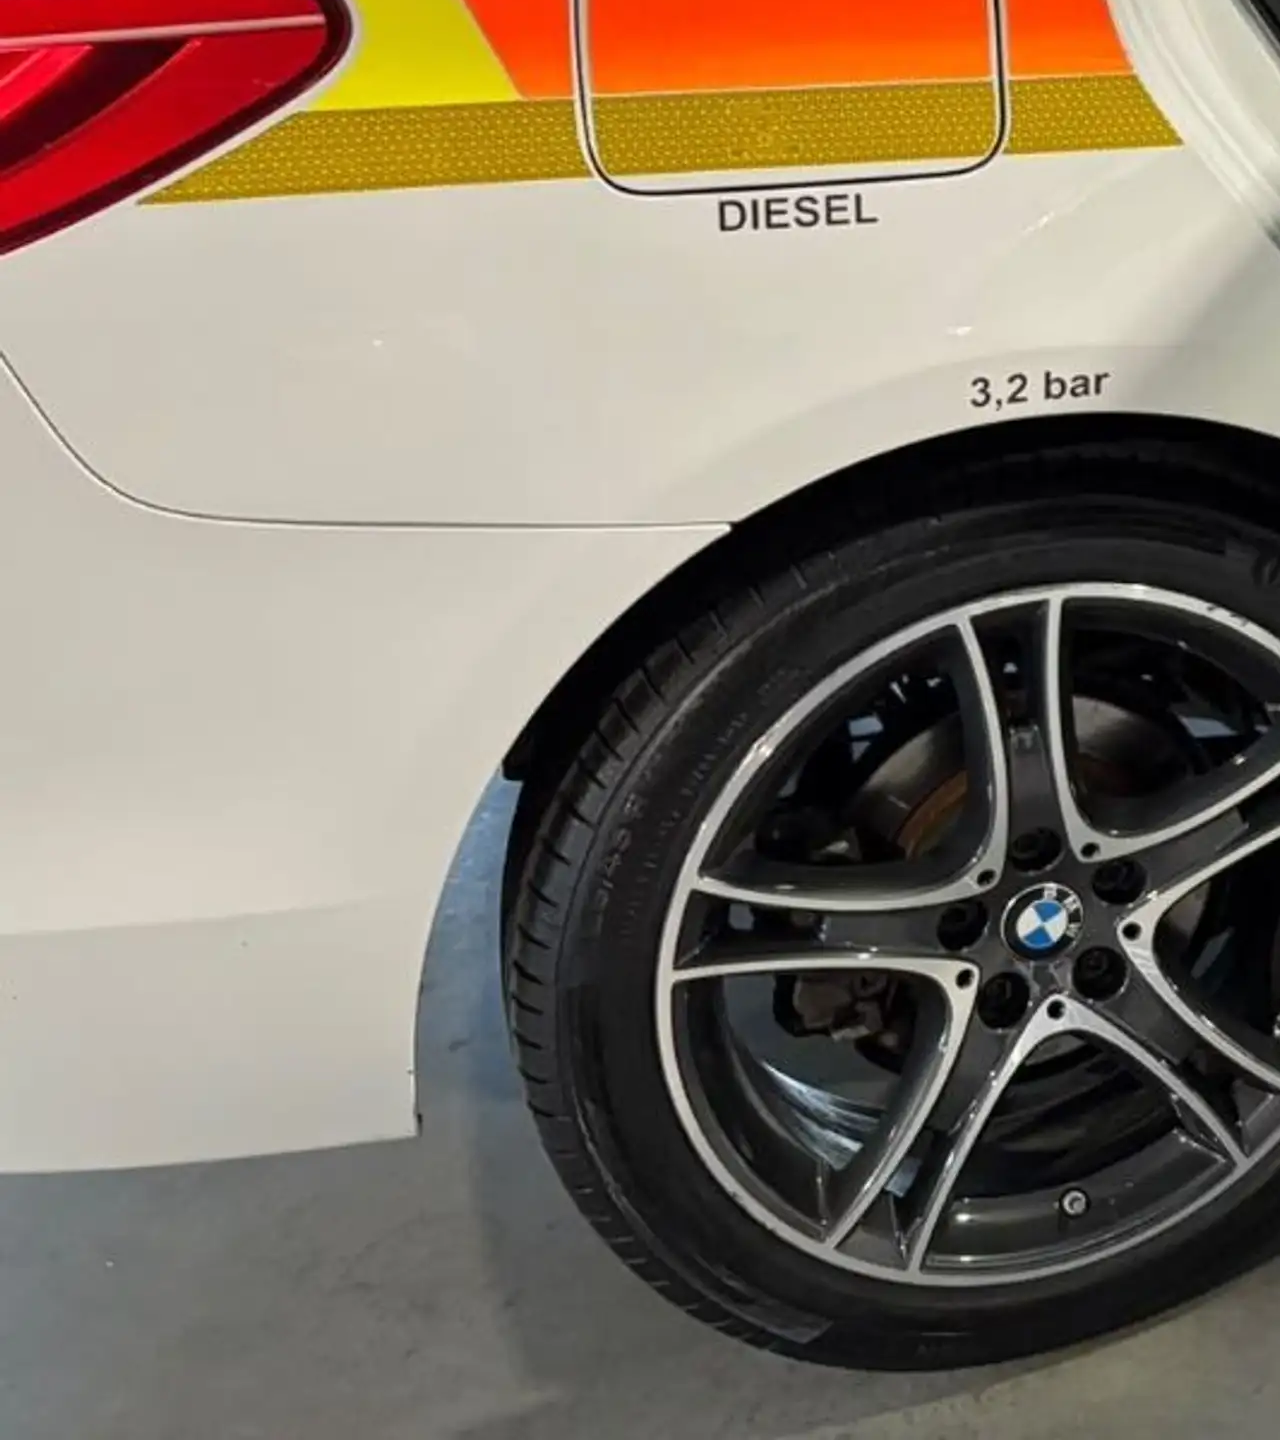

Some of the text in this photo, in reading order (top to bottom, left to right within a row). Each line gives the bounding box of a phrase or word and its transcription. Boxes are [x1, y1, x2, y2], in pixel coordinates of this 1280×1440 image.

[718, 193, 879, 232] DIESEL
[970, 370, 1111, 412] 3,2 bar
